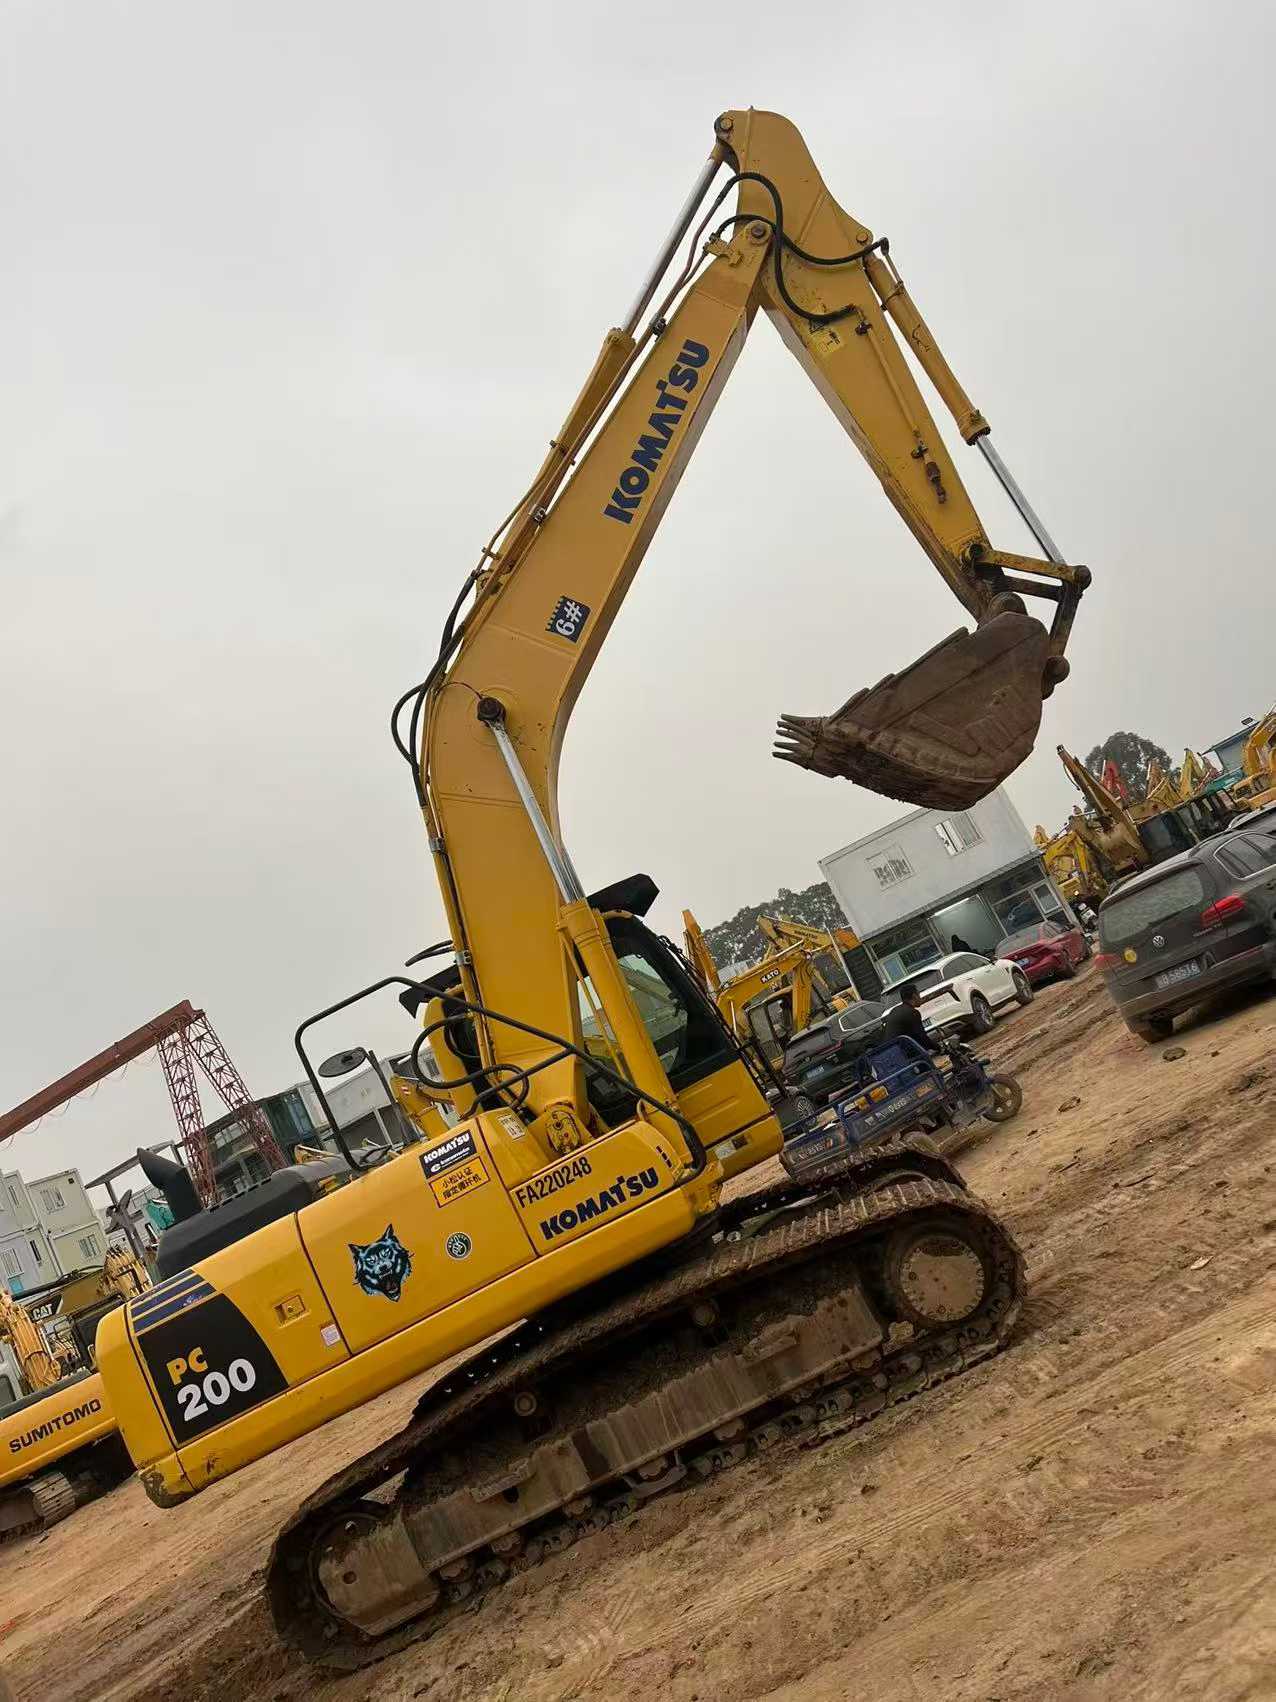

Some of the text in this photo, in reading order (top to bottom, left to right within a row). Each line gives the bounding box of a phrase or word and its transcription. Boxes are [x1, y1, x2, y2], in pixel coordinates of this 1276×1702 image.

[604, 339, 710, 524] KOMATSU
[761, 969, 779, 983] KATO
[423, 1132, 470, 1164] KOMATSU
[515, 1156, 593, 1209] FA220248
[540, 1167, 659, 1240] KOMATSU
[31, 1303, 54, 1320] CAT
[166, 1347, 209, 1385] PC
[177, 1358, 257, 1422] 200
[9, 1398, 102, 1453] SUMITOMO
